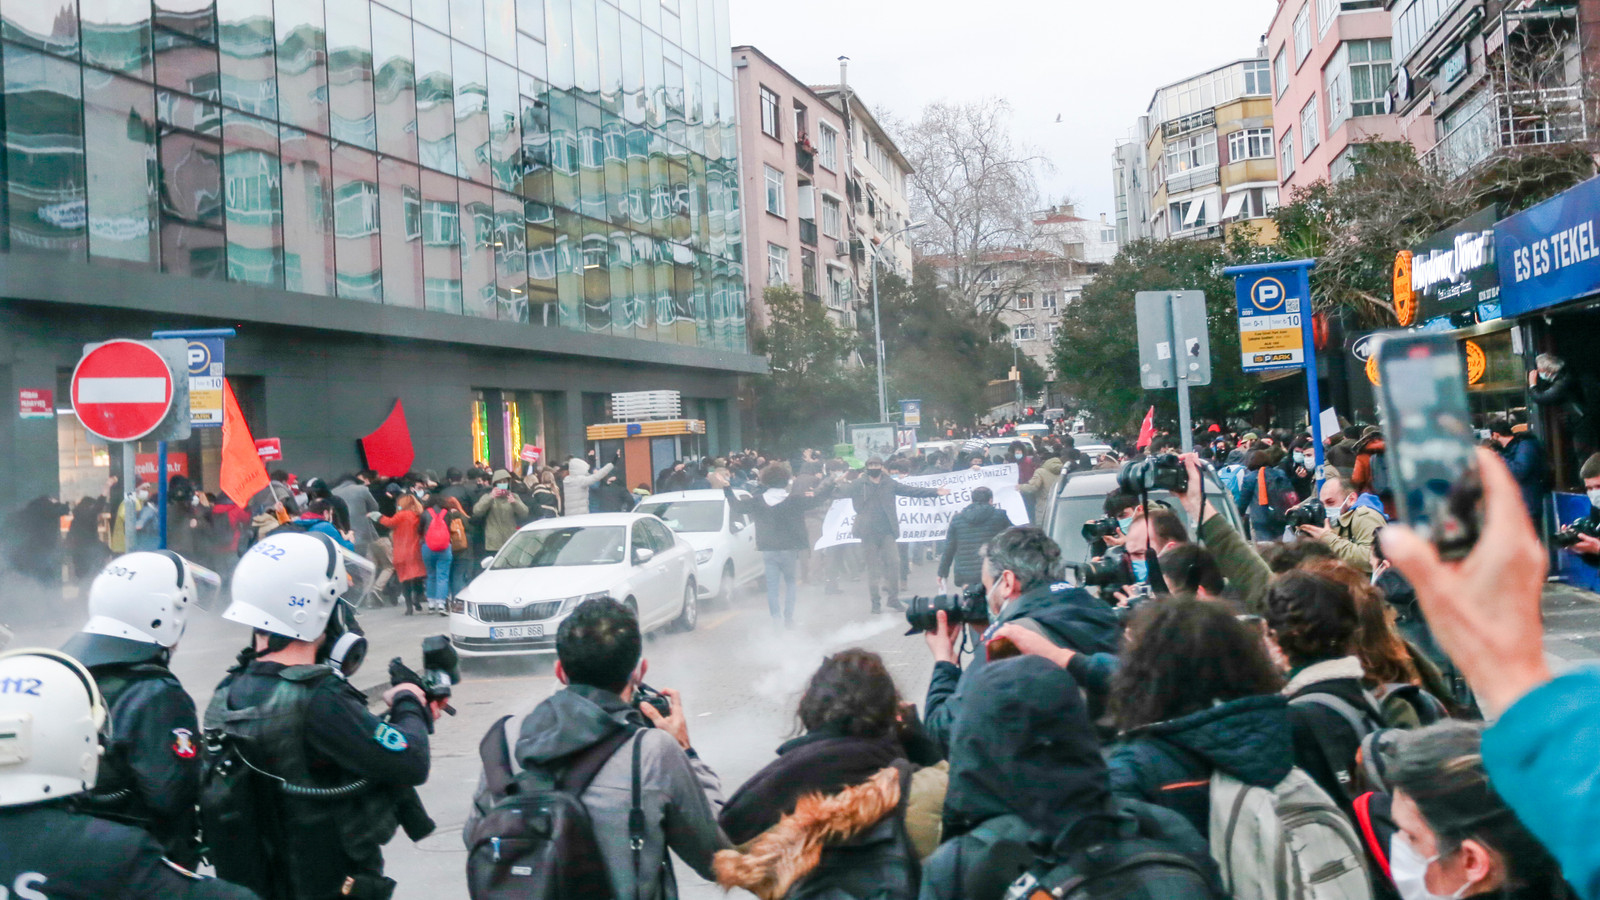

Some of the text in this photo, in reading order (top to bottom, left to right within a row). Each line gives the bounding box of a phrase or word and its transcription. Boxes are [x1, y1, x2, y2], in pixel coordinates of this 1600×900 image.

[1514, 220, 1599, 283] ES ES TEKEL
[1259, 285, 1278, 303] P
[1287, 315, 1300, 326] 10
[211, 378, 222, 388] 10
[626, 423, 642, 437] P
[288, 596, 305, 608] 34
